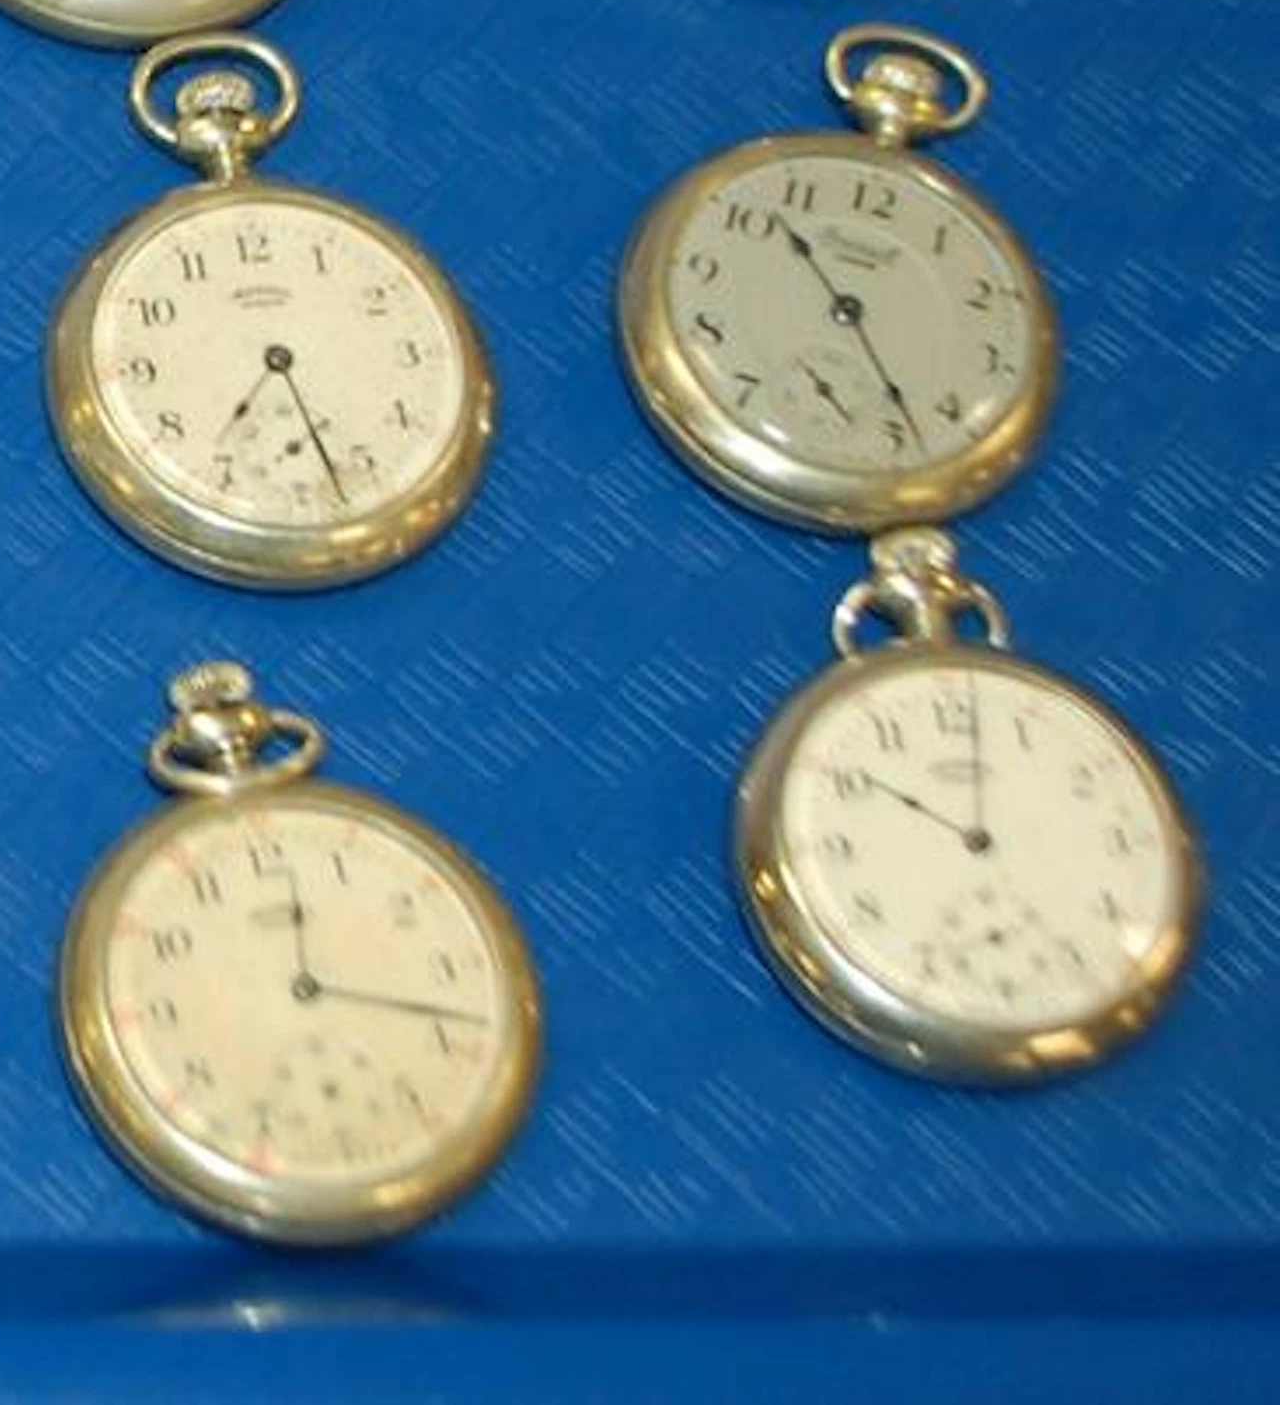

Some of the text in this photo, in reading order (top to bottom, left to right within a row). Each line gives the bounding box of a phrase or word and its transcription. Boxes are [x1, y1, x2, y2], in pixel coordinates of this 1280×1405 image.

[783, 178, 816, 212] 11
[851, 180, 896, 219] 12
[725, 204, 775, 239] 10
[235, 235, 272, 263] 12
[933, 226, 946, 256] 1
[178, 251, 206, 281] 11
[312, 243, 328, 274] 1
[689, 254, 719, 284] 9
[365, 287, 389, 316] 2
[966, 278, 993, 312] 2
[139, 298, 176, 328] 10
[395, 340, 422, 367] 3
[129, 357, 157, 384] 9
[734, 373, 761, 408] 7
[389, 398, 413, 430] 4
[935, 393, 960, 422] 4
[155, 412, 185, 442] 8
[213, 454, 234, 490] 7
[349, 445, 375, 480] 5
[872, 712, 905, 752] 11
[249, 842, 291, 877] 12
[192, 873, 222, 905] 11
[152, 927, 192, 962] 10
